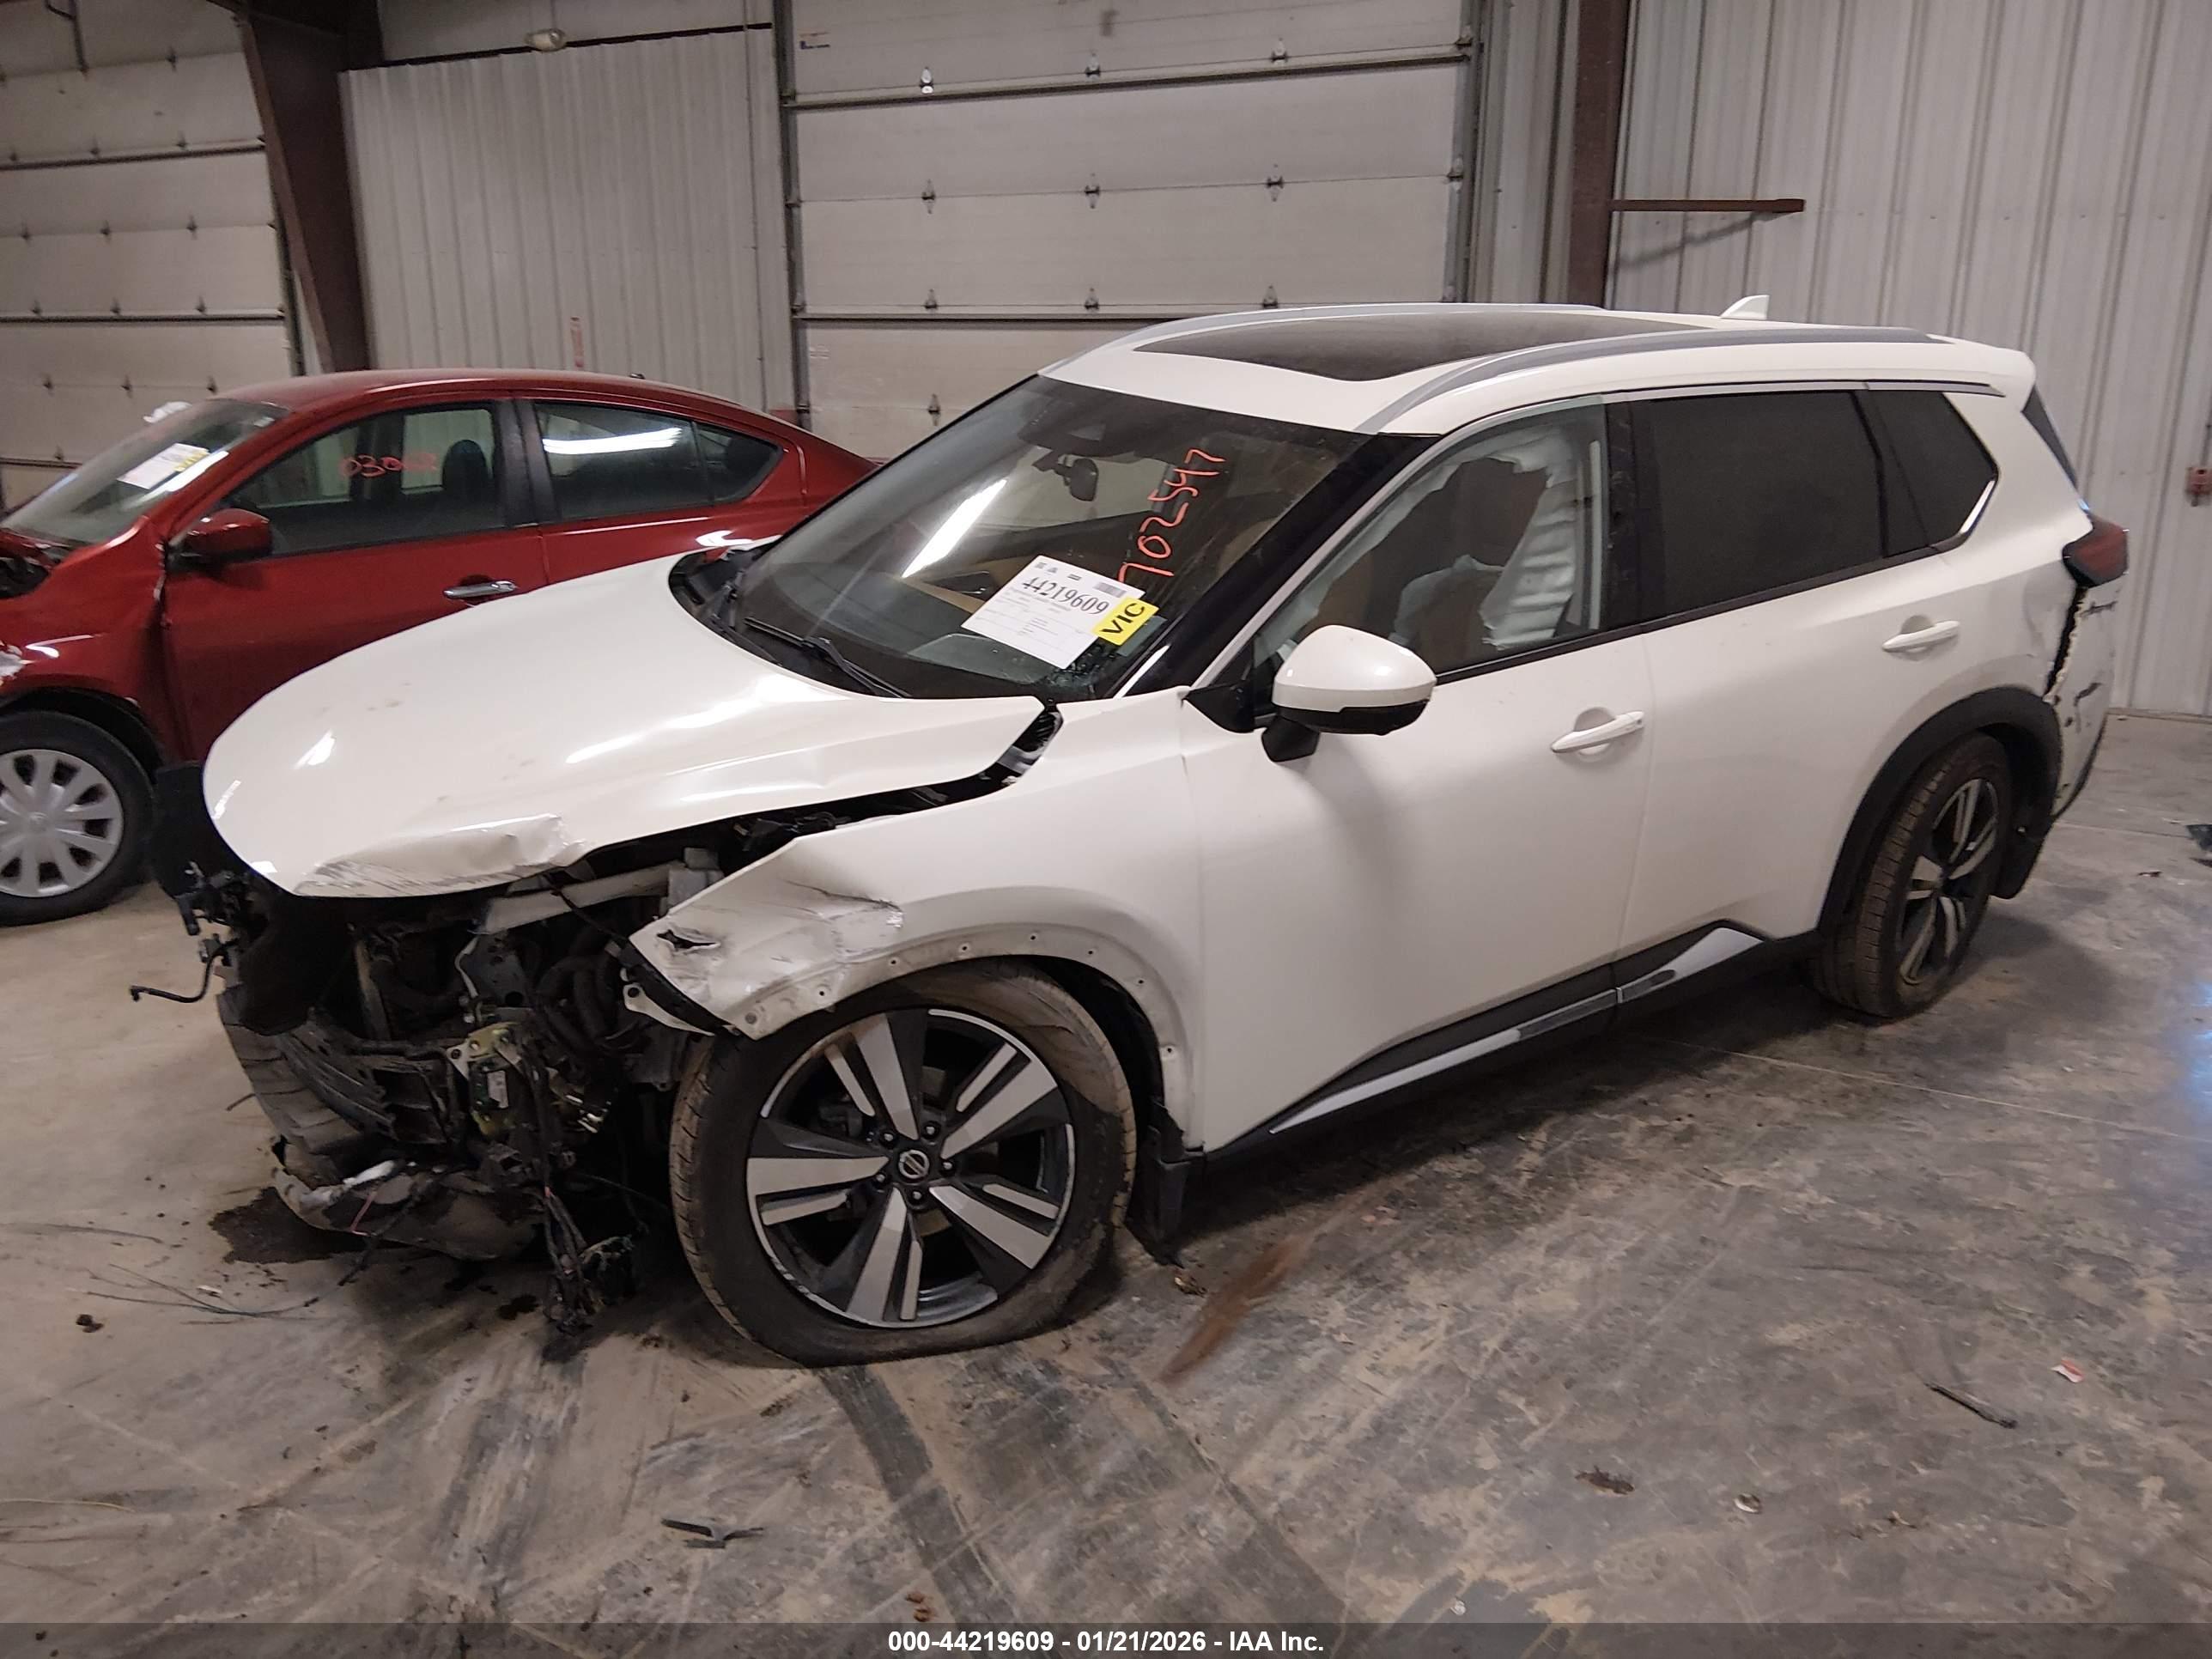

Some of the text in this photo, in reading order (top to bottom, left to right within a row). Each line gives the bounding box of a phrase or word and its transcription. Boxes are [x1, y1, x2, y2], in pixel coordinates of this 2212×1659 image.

[1117, 447, 1227, 583] 702547
[1022, 576, 1110, 615] 44219609
[1099, 602, 1146, 636] VIC
